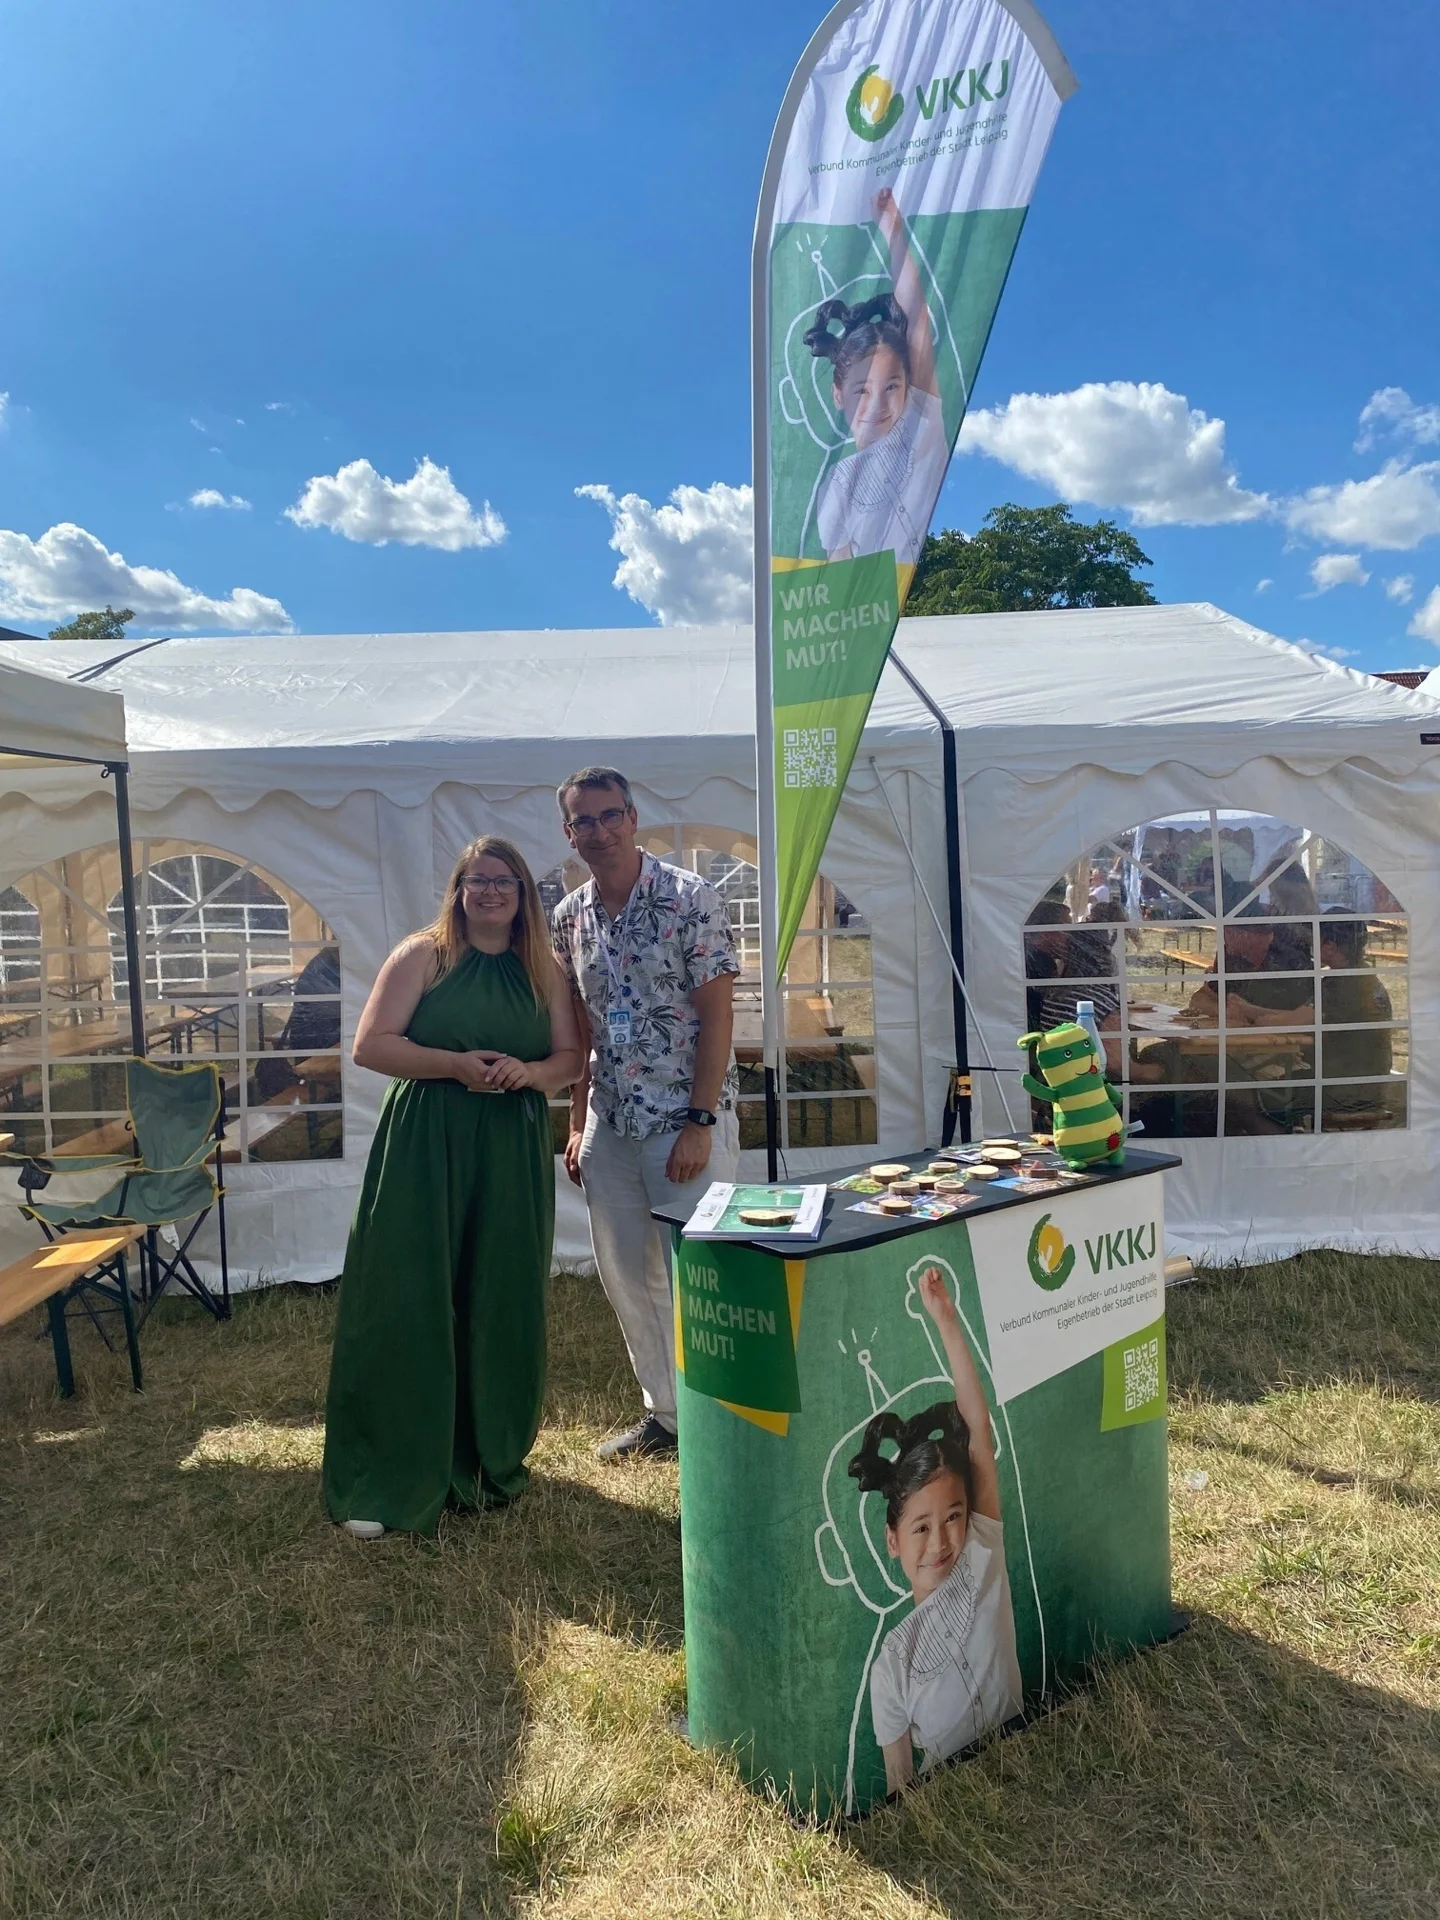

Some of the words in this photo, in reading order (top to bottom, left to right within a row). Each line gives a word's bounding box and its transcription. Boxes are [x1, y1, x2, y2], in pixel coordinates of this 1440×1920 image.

[915, 59, 1009, 120] VKKJ
[808, 160, 844, 176] Verbund
[934, 127, 953, 140] und
[930, 146, 946, 157] der
[948, 138, 972, 154] Stadt
[974, 129, 1008, 146] Leipzig
[780, 583, 831, 611] WIR
[783, 600, 891, 641] MACHEN
[786, 640, 847, 670] MUT!
[1084, 1222, 1155, 1275] VKKJ
[685, 1261, 720, 1293] WIR
[688, 1294, 777, 1335] MACHEN
[1000, 1312, 1032, 1333] Verbund
[1032, 1299, 1076, 1322] Kommunaler
[1077, 1290, 1102, 1306] Kinder-
[1103, 1284, 1118, 1297] und
[1119, 1271, 1157, 1293] Jugendhilfe
[1057, 1303, 1101, 1330] Eigenbetrieb
[1102, 1301, 1114, 1313] der
[1115, 1294, 1135, 1310] Stadt
[1136, 1288, 1158, 1304] Leipzig
[691, 1326, 736, 1361] MUT!
